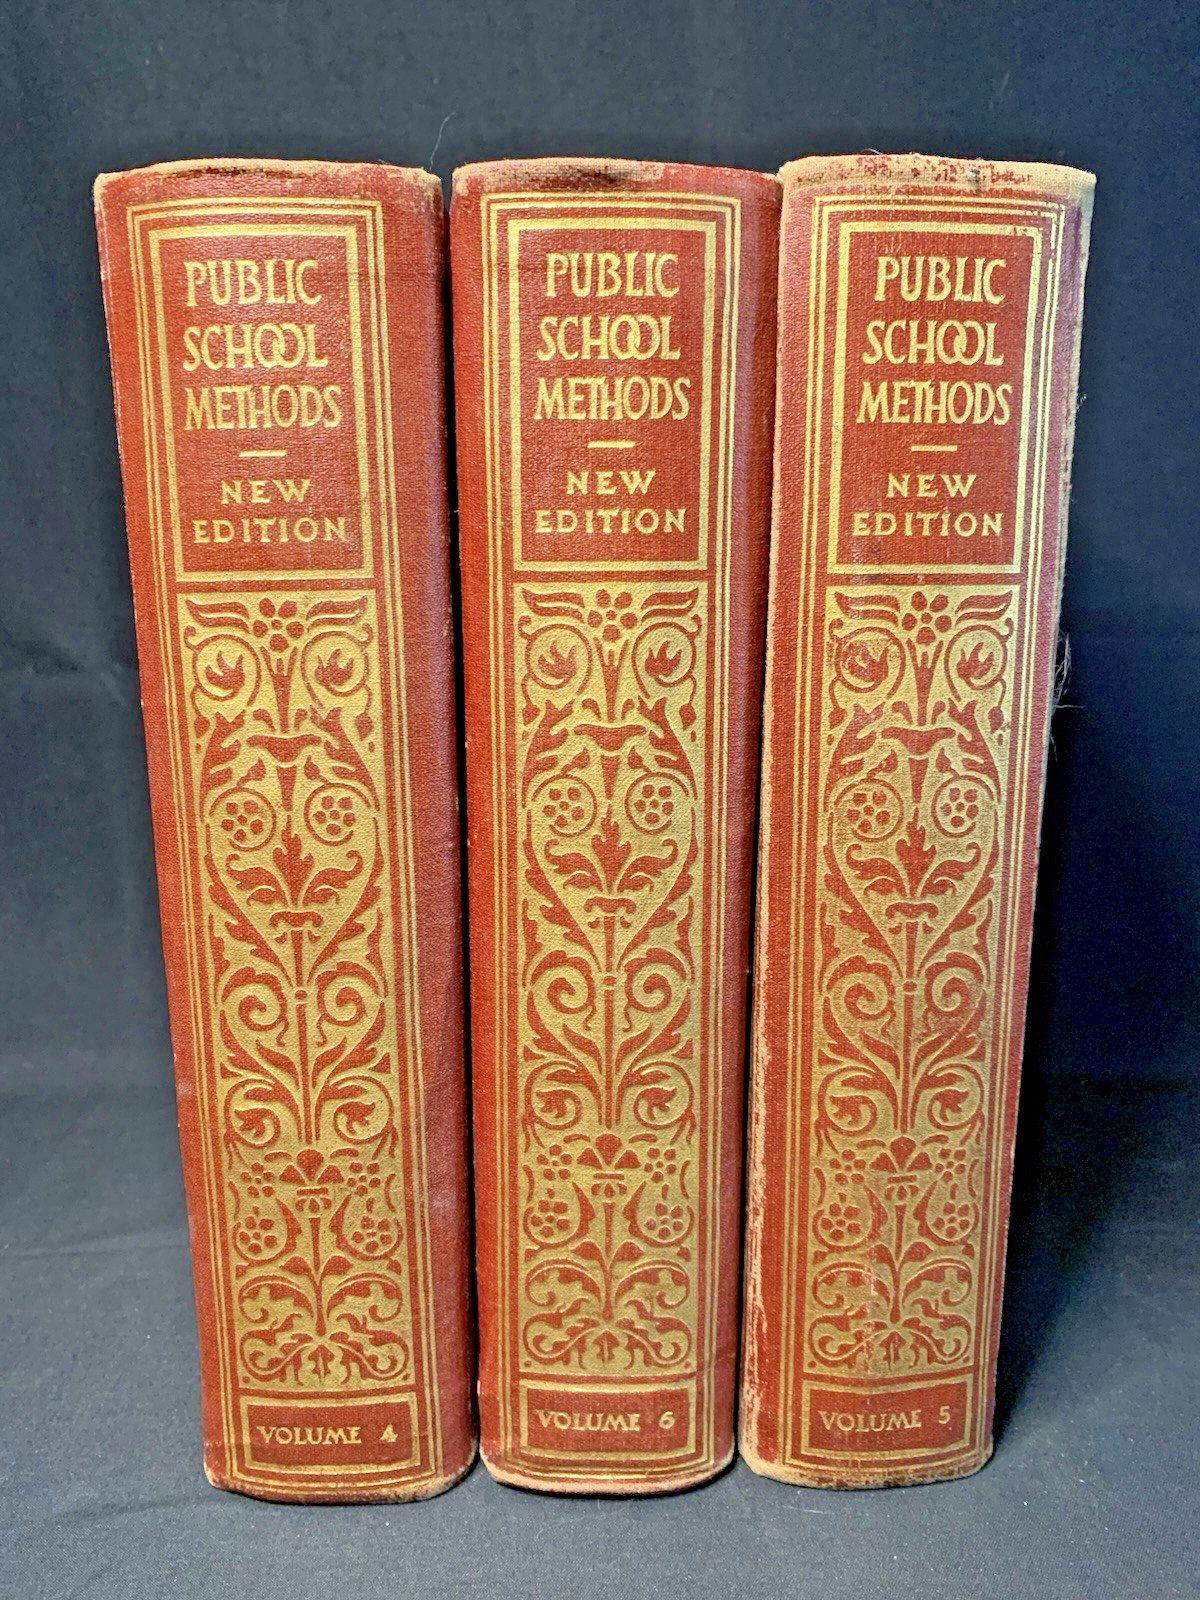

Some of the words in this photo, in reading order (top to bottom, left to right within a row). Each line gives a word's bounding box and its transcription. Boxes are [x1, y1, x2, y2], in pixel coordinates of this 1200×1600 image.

[184, 258, 322, 306] PUBLIC
[547, 252, 679, 297] PUBLIC
[875, 257, 1005, 304] PUBLIC
[183, 323, 328, 371] SCHOOL
[536, 314, 680, 361] SCHOOL
[863, 321, 1004, 366] SCHOOL
[186, 386, 342, 430] METHODS
[533, 376, 690, 420] METHODS
[856, 380, 1012, 425] METHODS
[221, 479, 311, 504] NEW
[567, 470, 655, 495] NEW
[887, 473, 976, 498] NEW
[193, 517, 349, 543] EDITION
[535, 507, 685, 534] EDITION
[852, 511, 1002, 537] EDITION
[257, 1426, 361, 1445] VOLUME
[381, 1425, 397, 1442] 4
[536, 1410, 640, 1432] VOLUME
[659, 1411, 675, 1430] 6
[820, 1410, 922, 1433] VOLUME
[938, 1406, 950, 1424] 5
